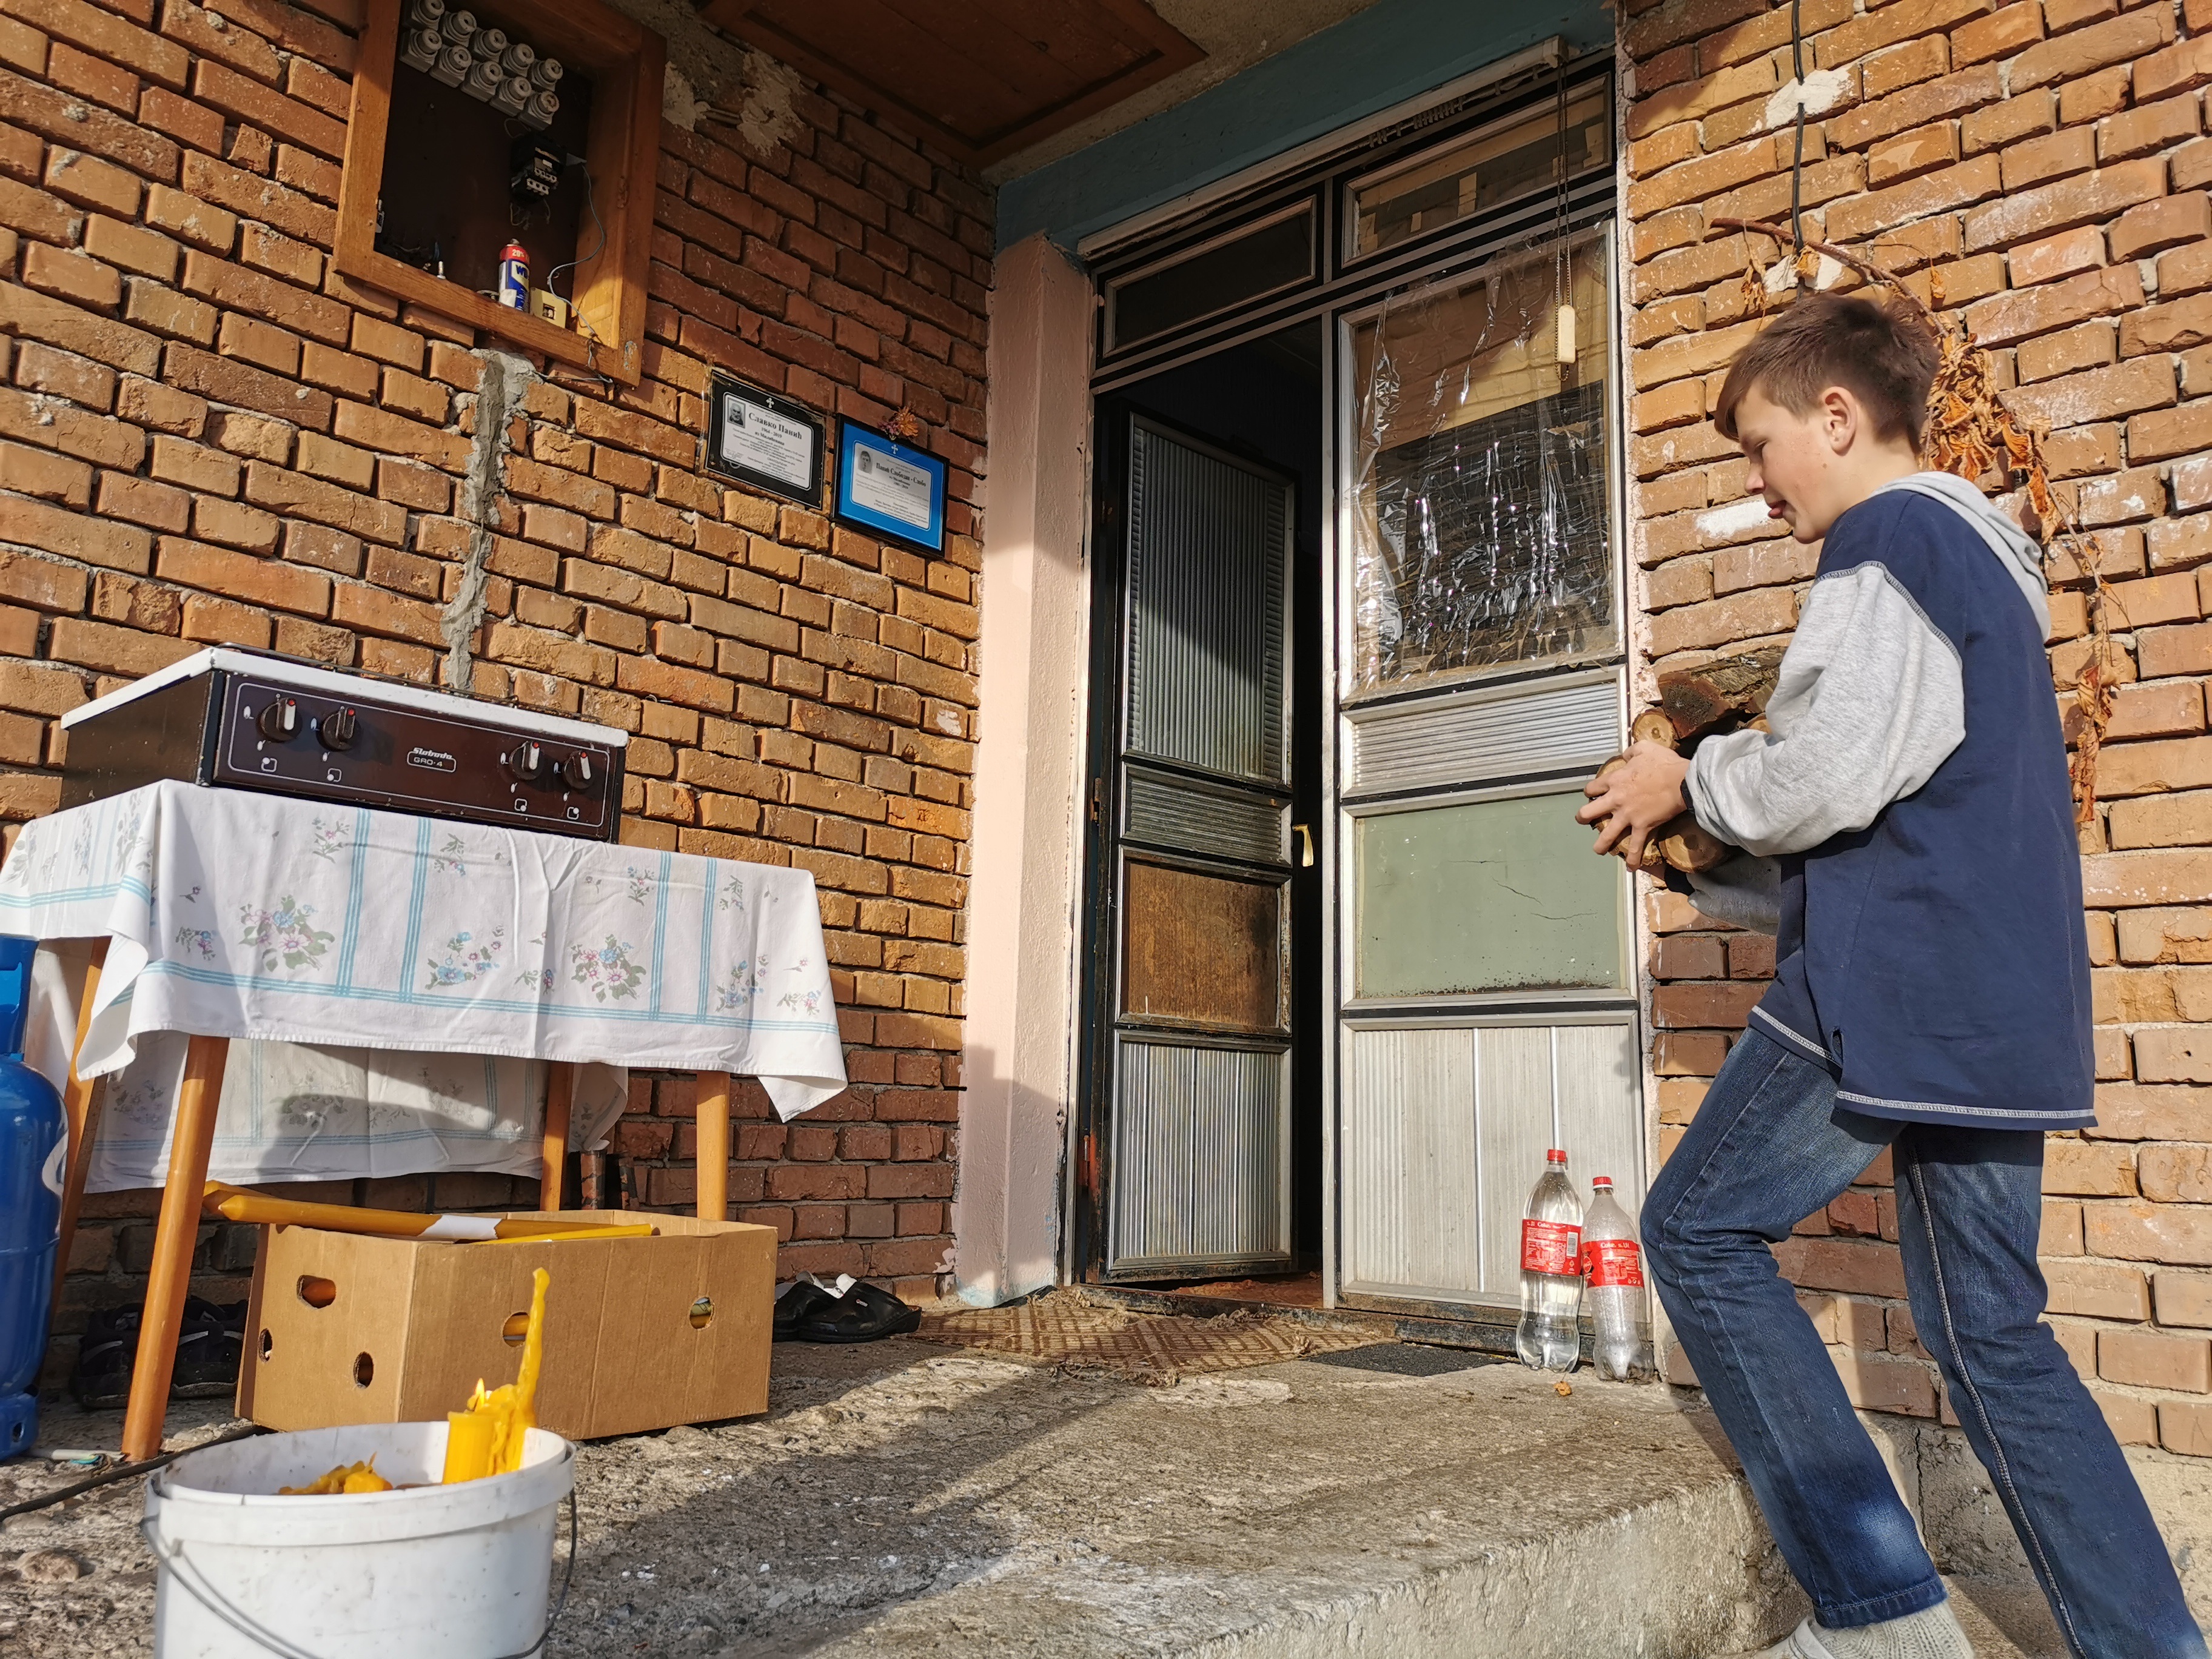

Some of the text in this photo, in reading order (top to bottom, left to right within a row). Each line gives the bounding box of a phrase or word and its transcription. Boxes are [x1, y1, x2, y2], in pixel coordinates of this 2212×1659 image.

[749, 412, 777, 429] Славко
[779, 424, 802, 440] Панић
[413, 747, 452, 760] Sloboda
